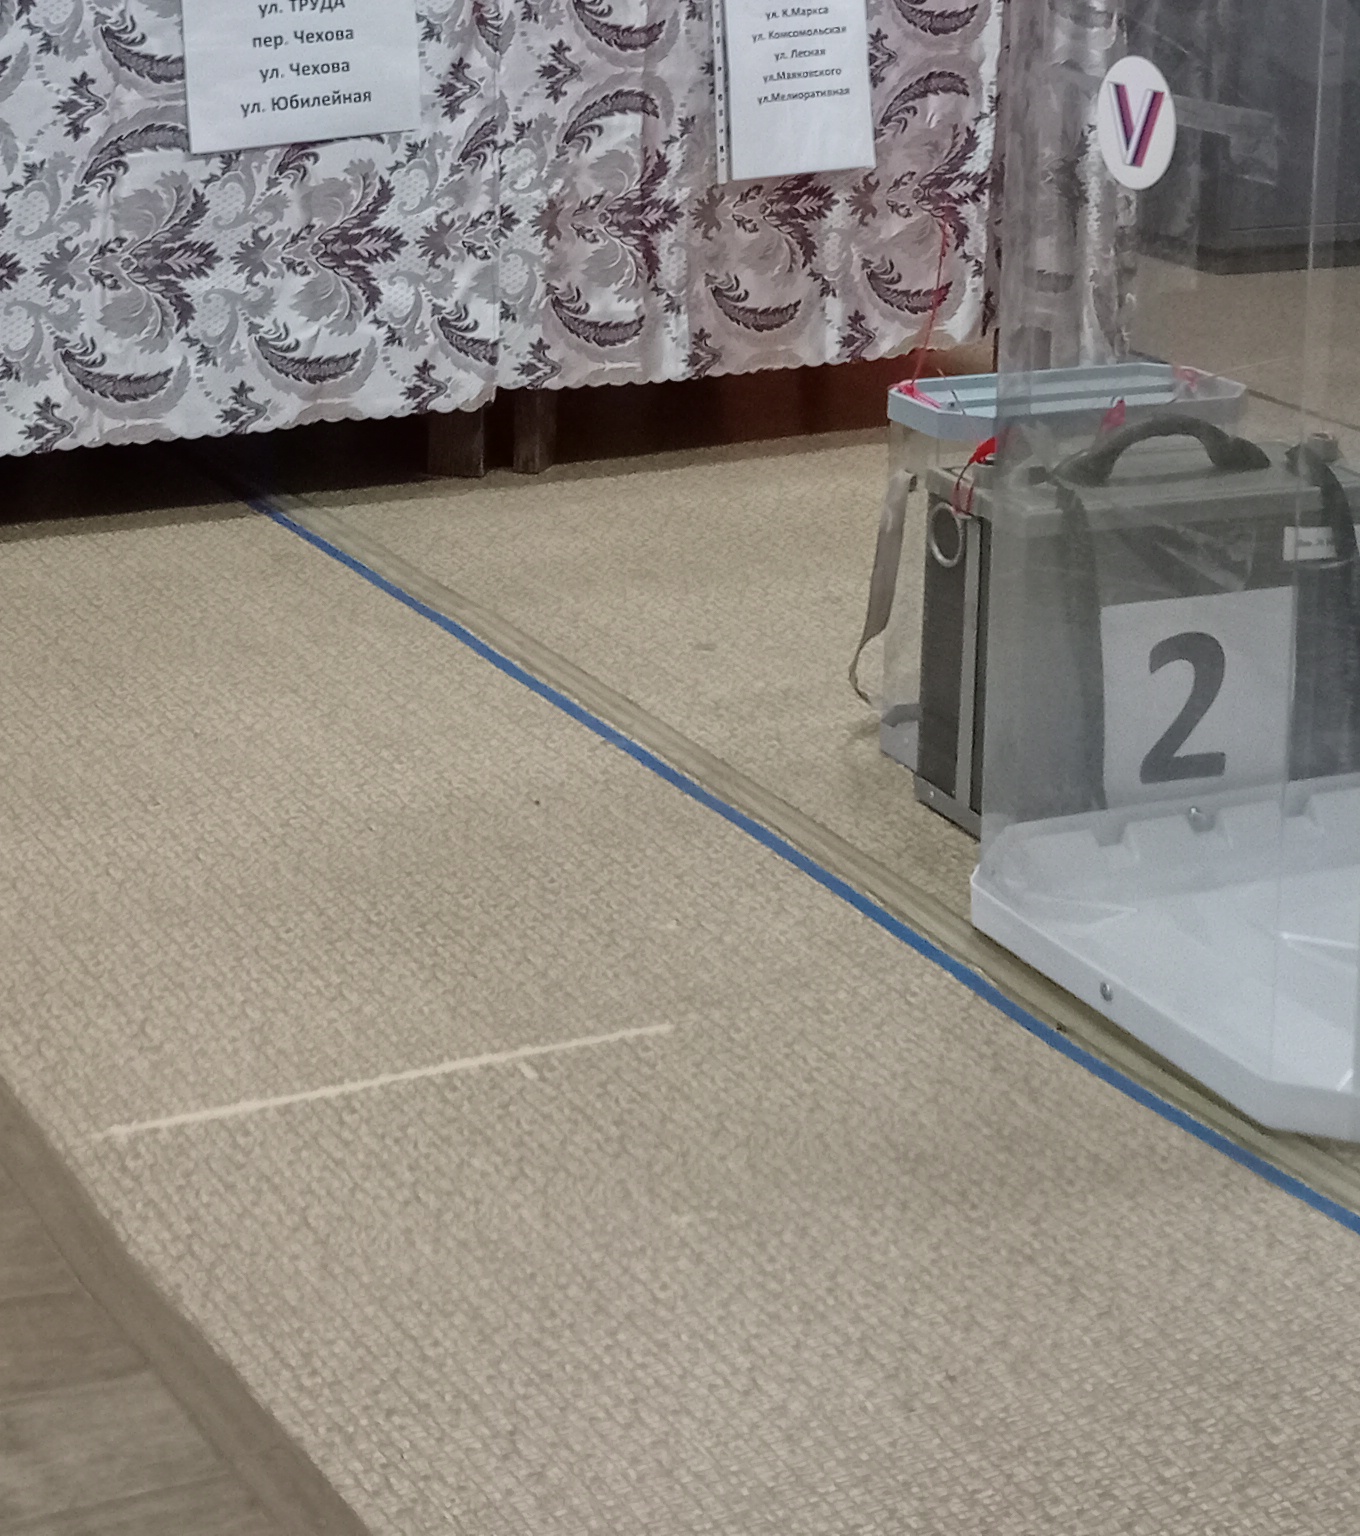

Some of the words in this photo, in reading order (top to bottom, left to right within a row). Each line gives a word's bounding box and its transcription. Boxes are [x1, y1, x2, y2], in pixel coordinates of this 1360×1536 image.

[258, 2, 283, 17] ул.
[252, 34, 289, 50] пер.
[293, 28, 354, 44] Чехова
[768, 25, 847, 40] Комсомольская
[790, 48, 826, 59] Лесная
[259, 67, 285, 83] ул.
[289, 61, 351, 77] Чехова
[240, 102, 266, 118] ул.
[271, 90, 373, 112] Юбилейная
[1140, 631, 1227, 784] 2
